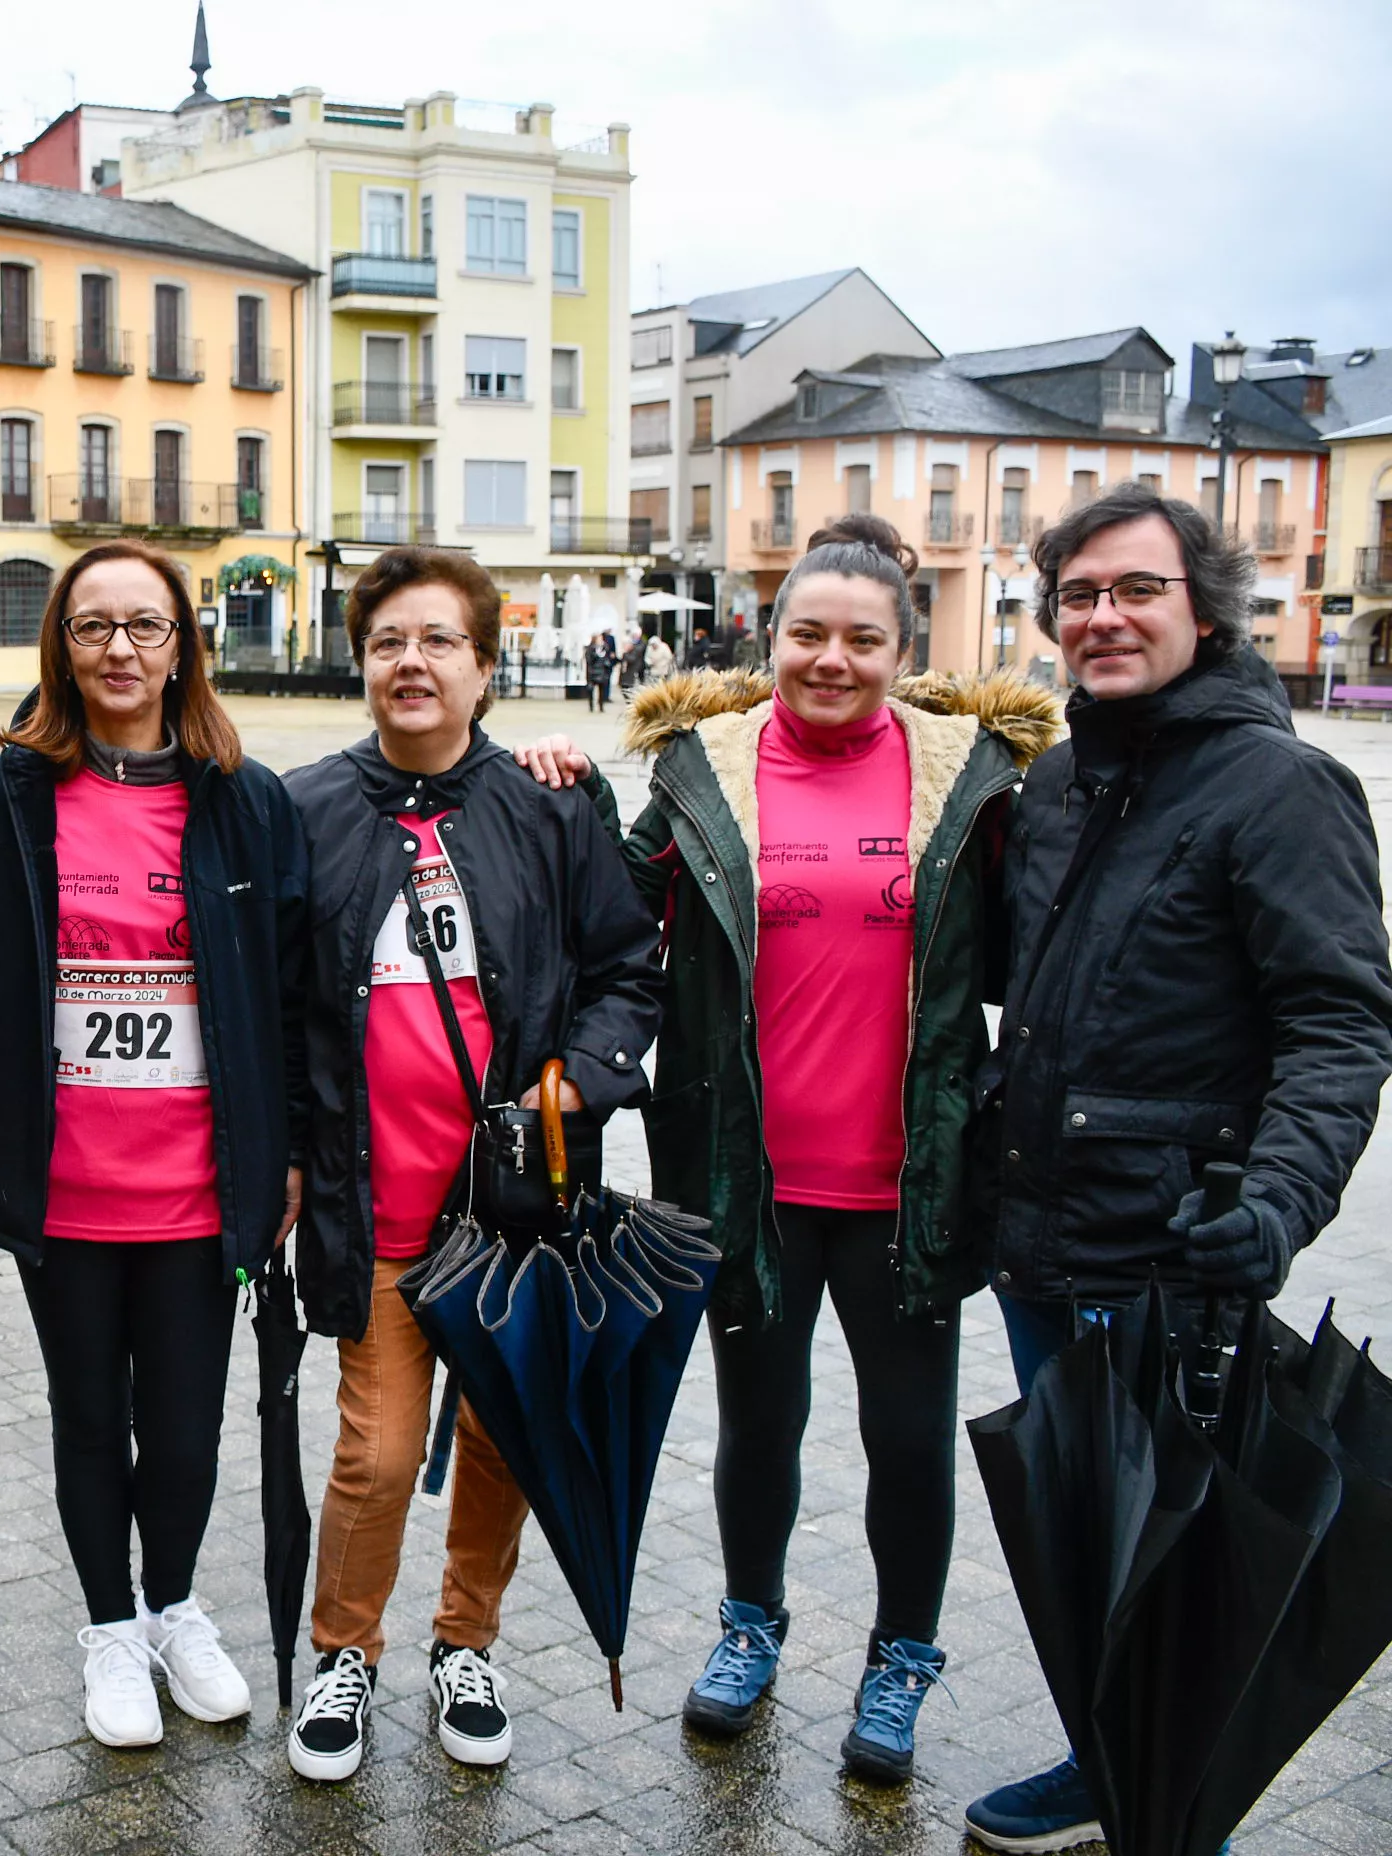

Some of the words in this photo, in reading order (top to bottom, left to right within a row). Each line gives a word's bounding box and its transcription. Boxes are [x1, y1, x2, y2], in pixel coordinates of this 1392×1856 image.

[757, 851, 829, 866] Ponferrada
[58, 872, 120, 883] yuntamiento
[421, 867, 439, 880] de
[58, 882, 119, 897] onferrada
[431, 880, 459, 896] 2024
[758, 907, 821, 919] onferrada
[863, 913, 895, 924] Pacto
[758, 920, 799, 930] eporte
[56, 937, 110, 952] onferrada
[56, 949, 91, 960] porte
[149, 950, 177, 960] Pacto
[60, 969, 120, 984] Carrera
[123, 971, 143, 984] de
[144, 971, 158, 984] la
[160, 971, 195, 988] muje
[58, 987, 68, 999] 10
[71, 990, 85, 999] de
[87, 989, 132, 1001] Marzo
[134, 988, 163, 1001] 2024
[85, 1011, 174, 1061] 292
